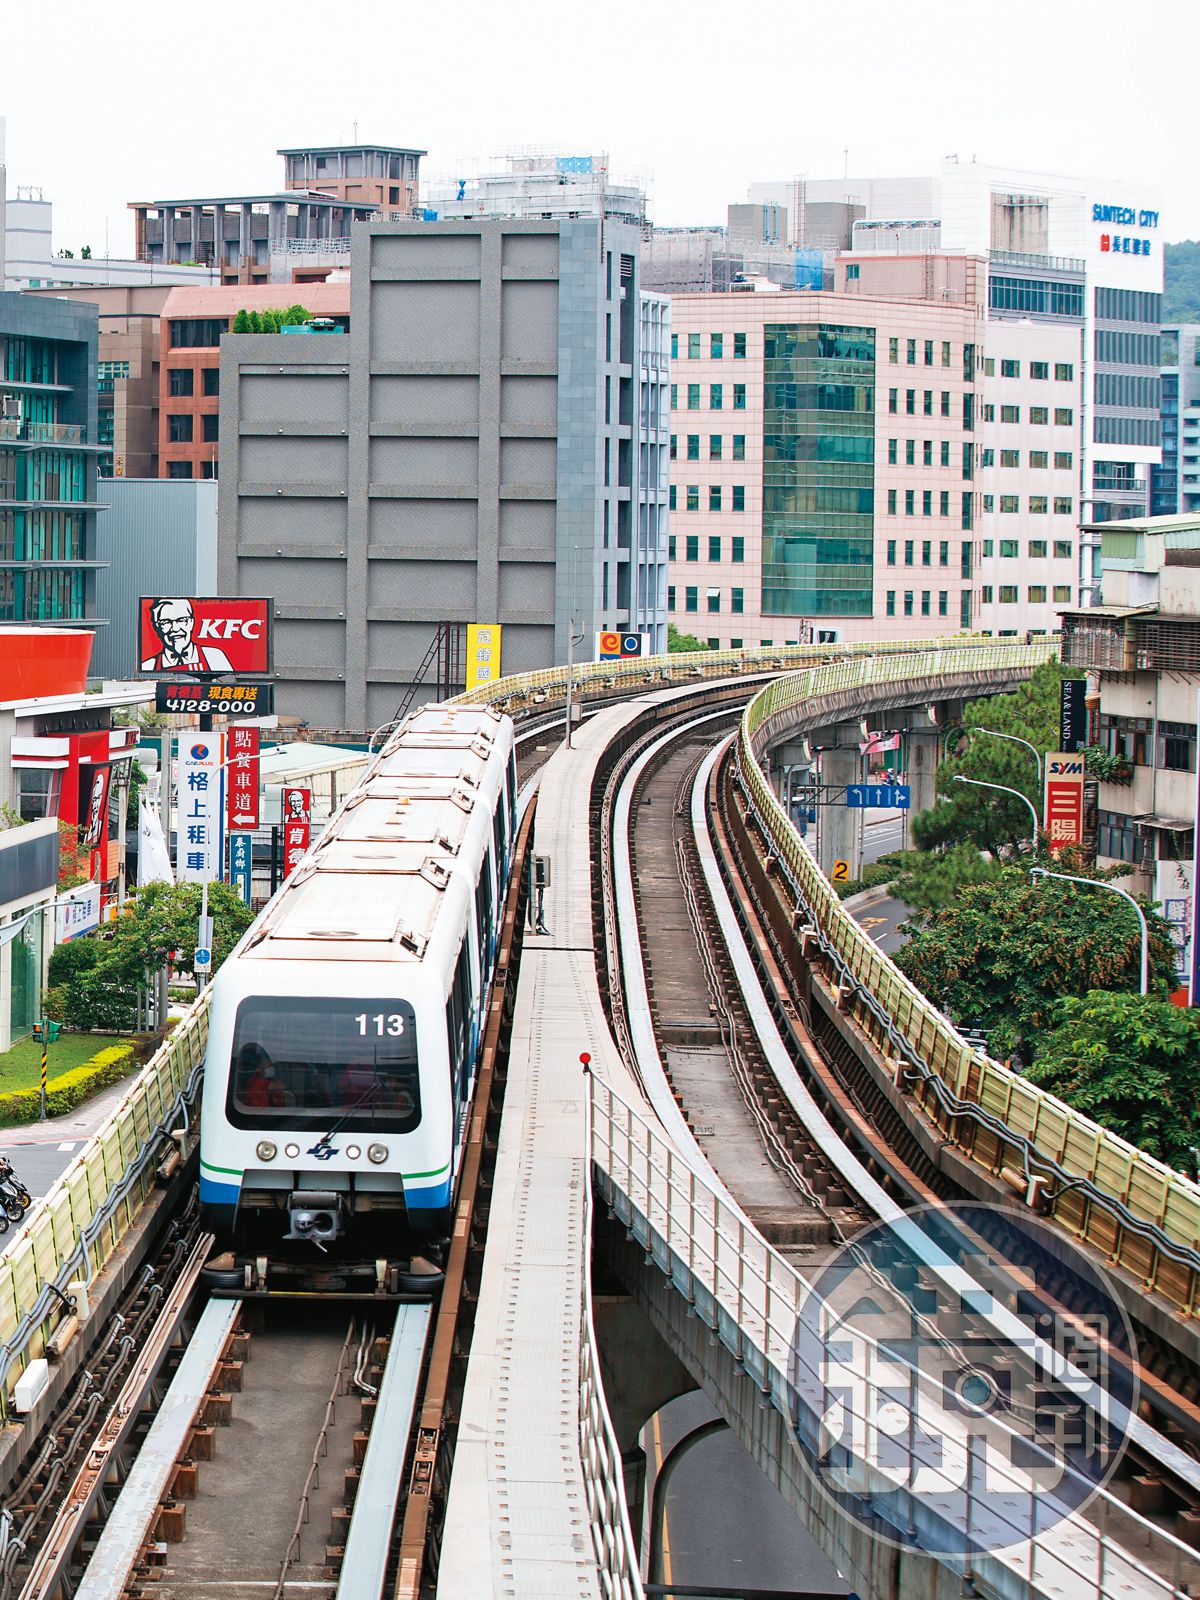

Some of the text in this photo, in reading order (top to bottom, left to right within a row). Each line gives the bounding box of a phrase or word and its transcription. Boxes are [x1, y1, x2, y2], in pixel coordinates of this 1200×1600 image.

[1093, 203, 1159, 228] SUNTECH CITY
[197, 618, 263, 640] KFC
[207, 686, 258, 701] 現食專送
[1062, 681, 1072, 701] SEA
[166, 699, 256, 714] 4128-000
[1062, 701, 1072, 710] &
[1061, 711, 1072, 740] LAND
[234, 730, 252, 811] 點餐車道
[1049, 762, 1082, 775] SYM
[186, 772, 211, 871] 格上租車
[1051, 790, 1077, 860] 三陽
[834, 862, 848, 880] 2
[355, 1013, 404, 1036] 113
